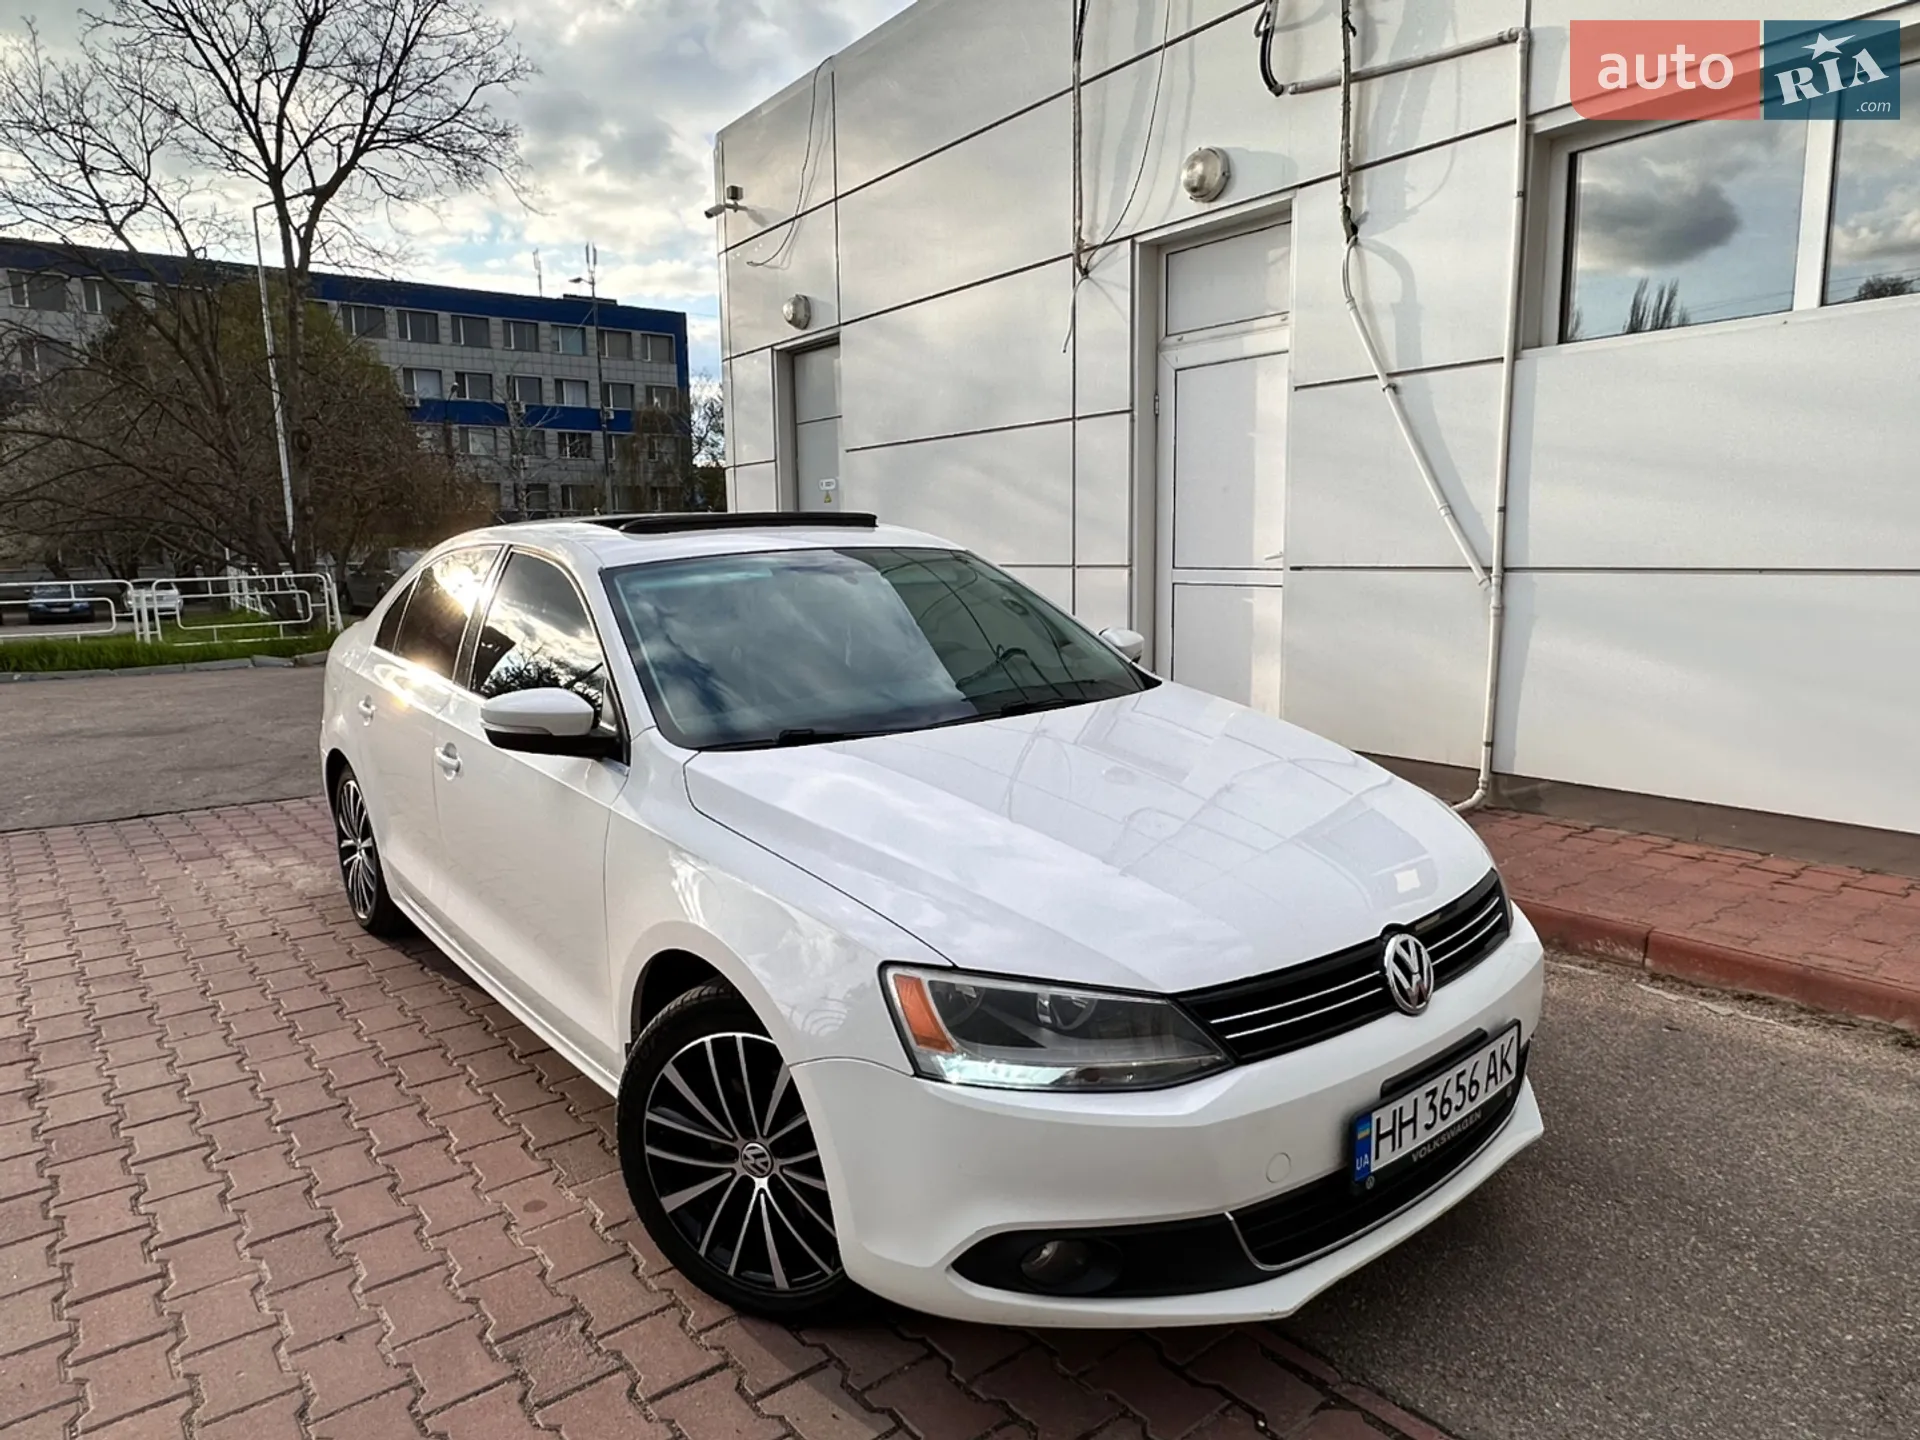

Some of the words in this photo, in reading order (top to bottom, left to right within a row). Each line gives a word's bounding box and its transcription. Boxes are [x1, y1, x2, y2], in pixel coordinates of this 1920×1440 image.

[1374, 1097, 1418, 1161] HH
[1424, 1060, 1480, 1131] 3656
[1484, 1036, 1515, 1094] AK
[1356, 1153, 1370, 1171] UA
[1411, 1109, 1482, 1162] VOLKSWAGEN
